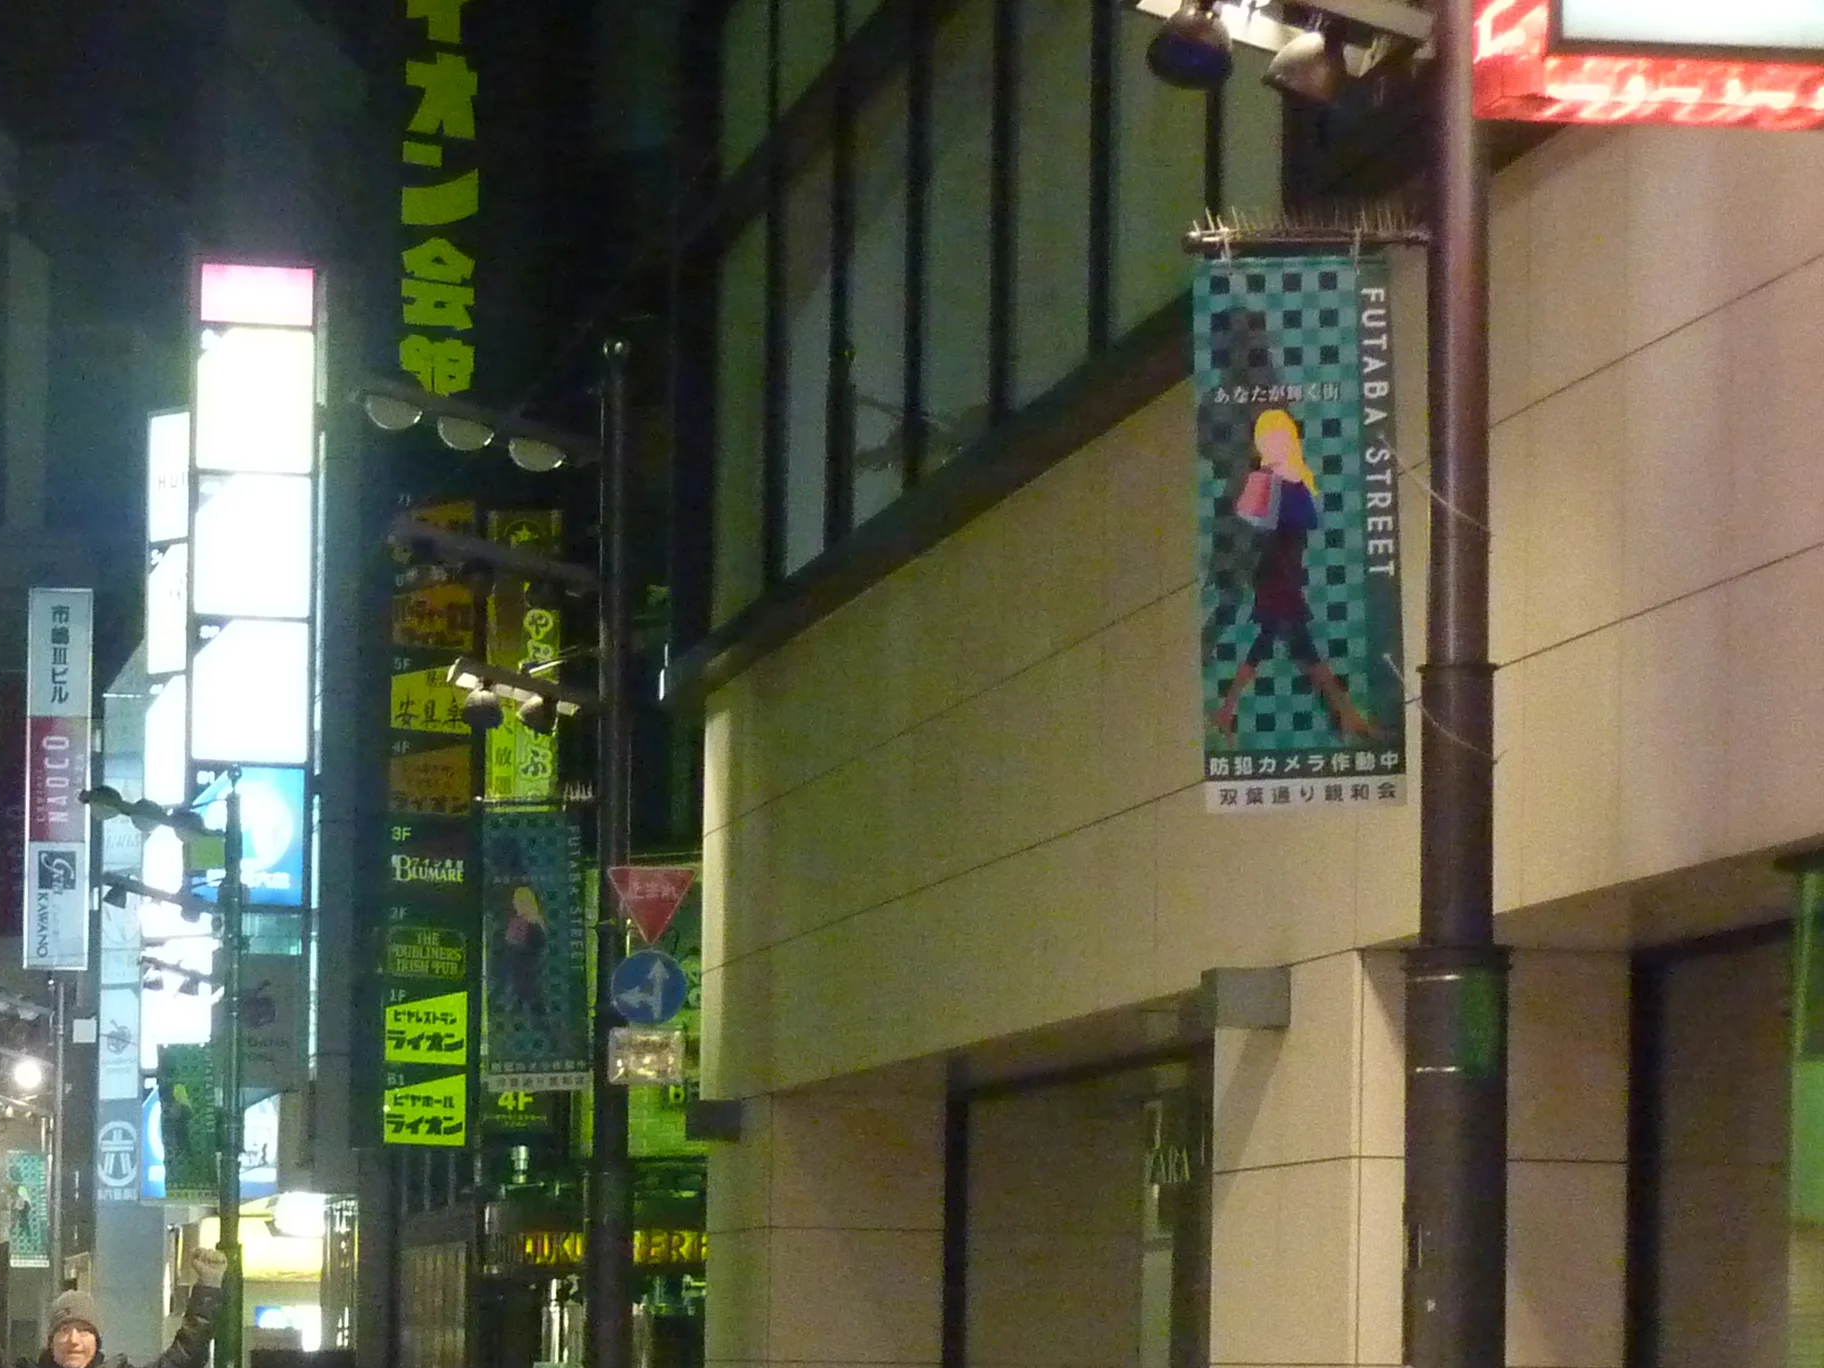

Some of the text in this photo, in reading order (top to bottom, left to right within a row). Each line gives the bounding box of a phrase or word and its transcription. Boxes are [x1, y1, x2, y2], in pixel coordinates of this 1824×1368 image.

[1360, 287, 1395, 577] FUTABA STREET
[1209, 751, 1399, 776] 防犯カメラ作動中
[1219, 781, 1397, 806] 双葉通り親和会
[390, 826, 413, 842] 3F
[35, 892, 49, 958] KAWANO
[393, 1009, 458, 1026] ビヤレストラン
[386, 1028, 465, 1052] ライオン
[392, 1094, 456, 1109] ビヤホール
[385, 1113, 464, 1136] ライオン
